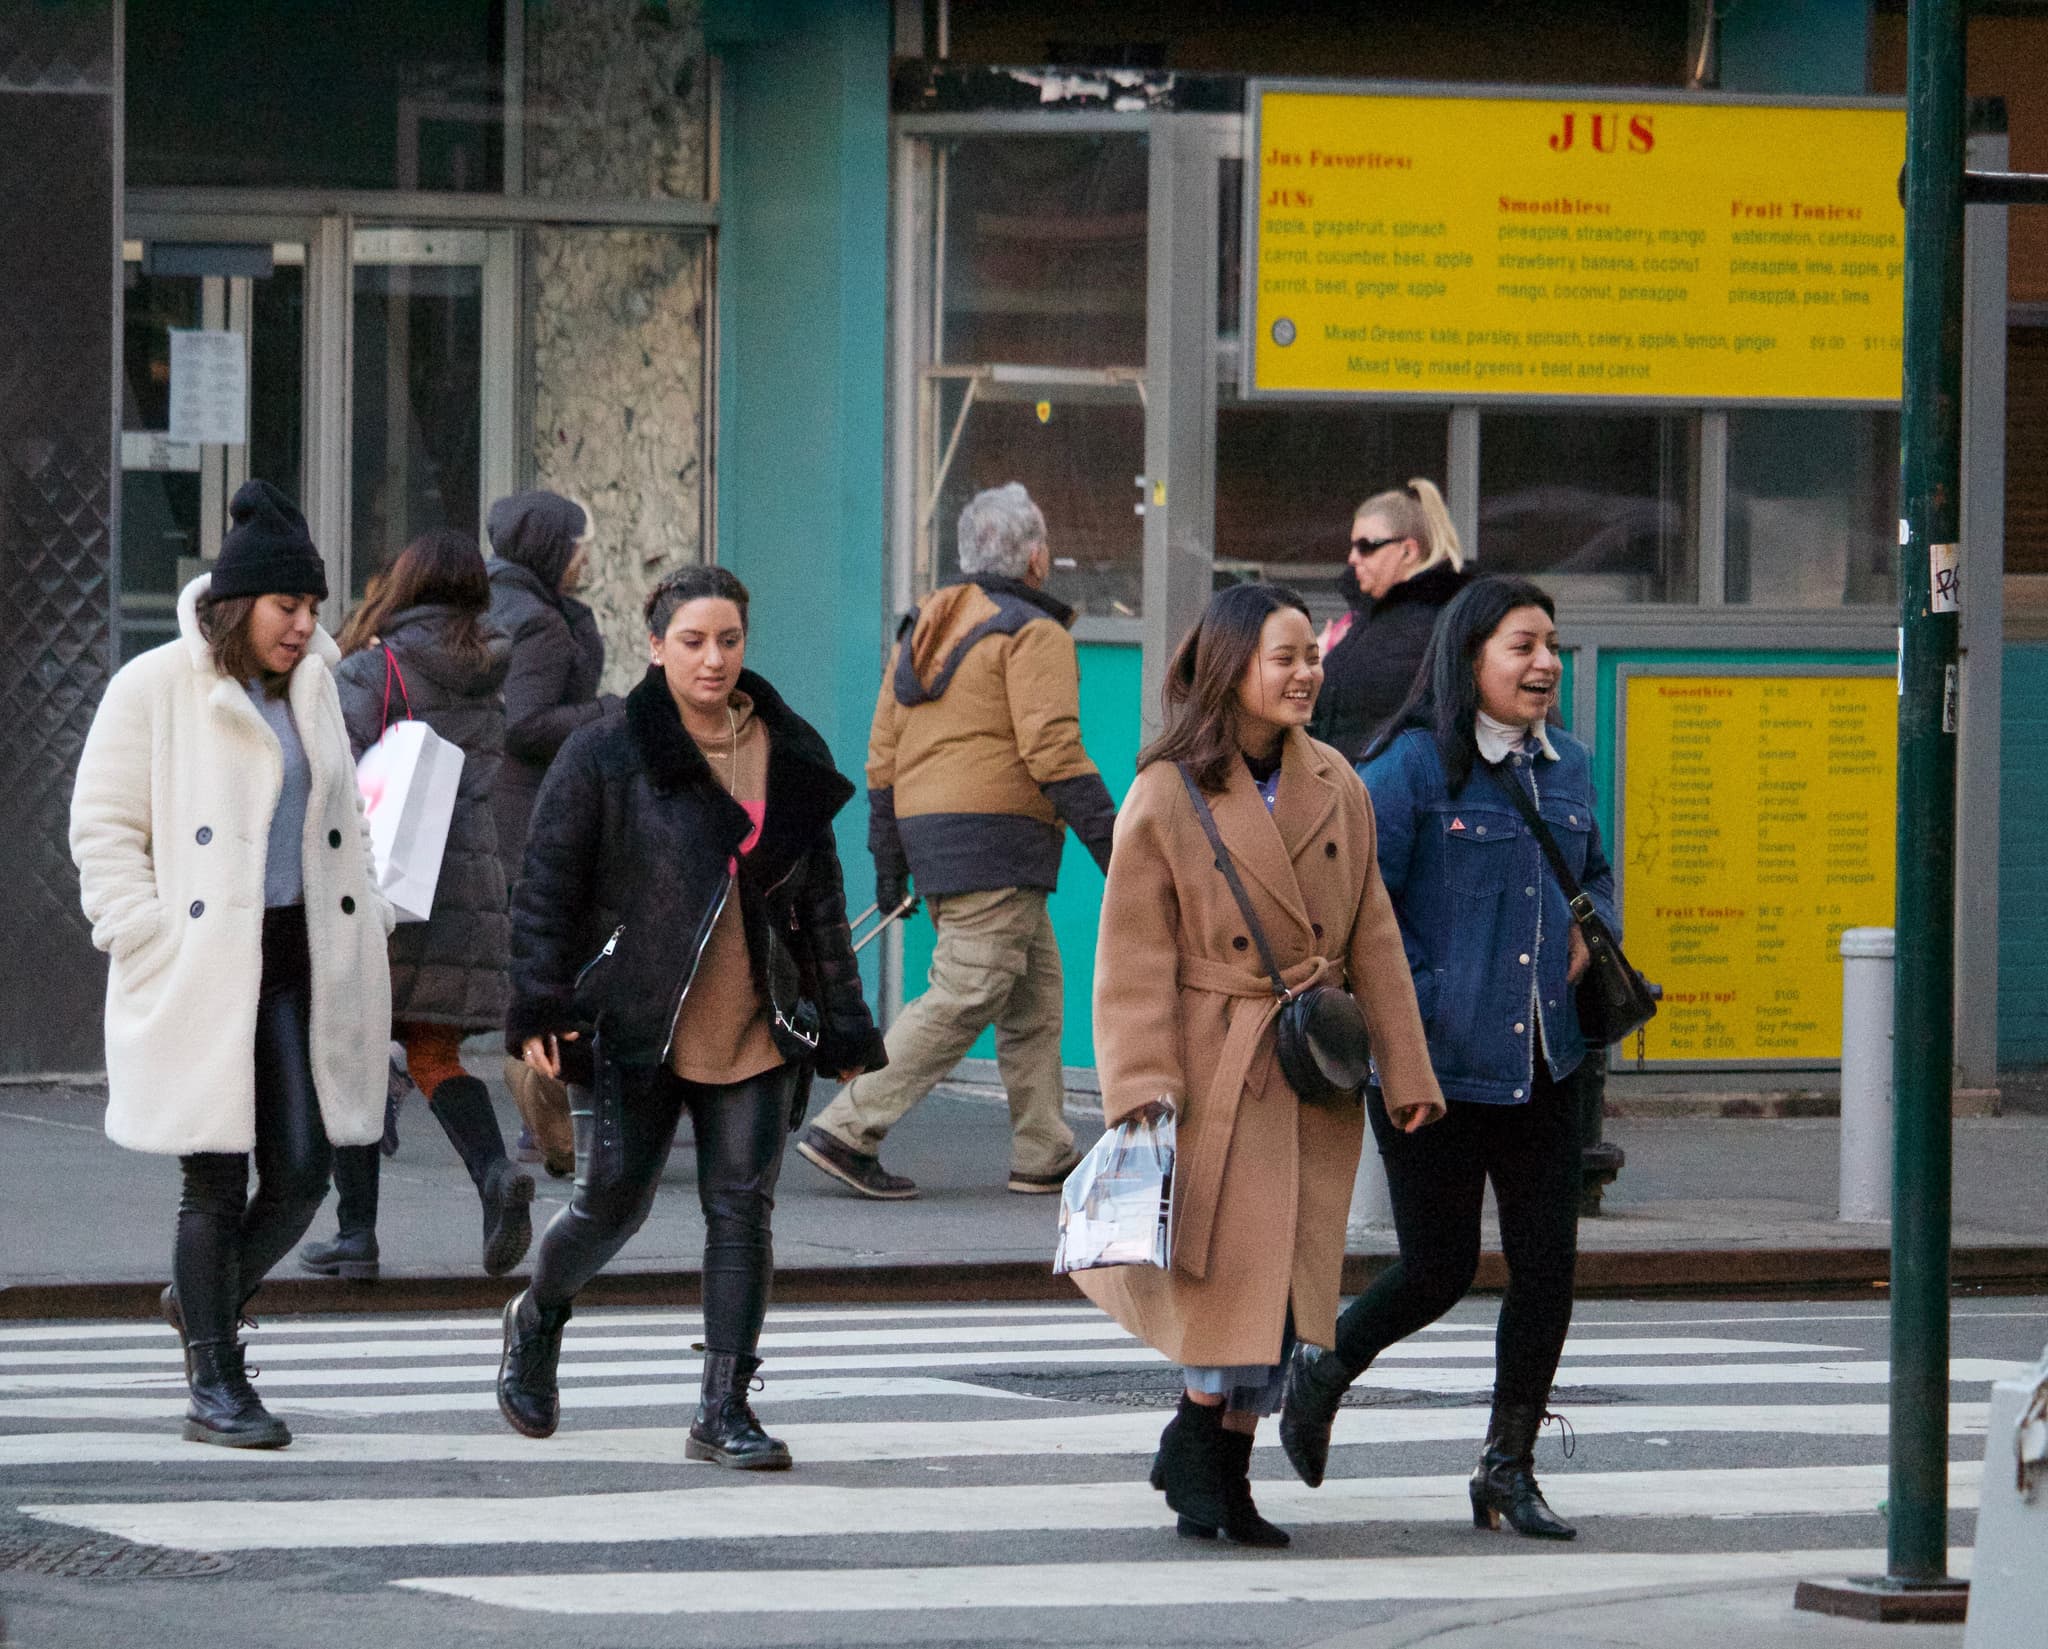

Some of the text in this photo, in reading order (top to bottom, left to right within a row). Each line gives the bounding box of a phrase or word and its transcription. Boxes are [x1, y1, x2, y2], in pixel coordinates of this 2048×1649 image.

[1549, 113, 1655, 154] JUS
[1267, 149, 1412, 170] Jus Favorites:
[1268, 190, 1313, 208] JUS:
[1499, 196, 1610, 215] Smoothies:
[1732, 201, 1861, 220] Fruit Tonics:
[1433, 253, 1473, 271] apple
[1643, 257, 1699, 273] coconut
[1407, 281, 1446, 298] apple
[1619, 286, 1687, 303] pineapple
[1842, 289, 1870, 304] lime
[1324, 324, 1367, 341] Mixed
[1734, 335, 1777, 353] ginger
[1348, 356, 1390, 373] Mixed
[1429, 359, 1471, 376] mixed
[1476, 361, 1523, 378] greens
[1541, 362, 1572, 376] beet
[1577, 362, 1604, 377] and
[1608, 363, 1650, 378] carrot
[1656, 906, 1694, 918] Fruit
[1698, 906, 1746, 918] Tonics
